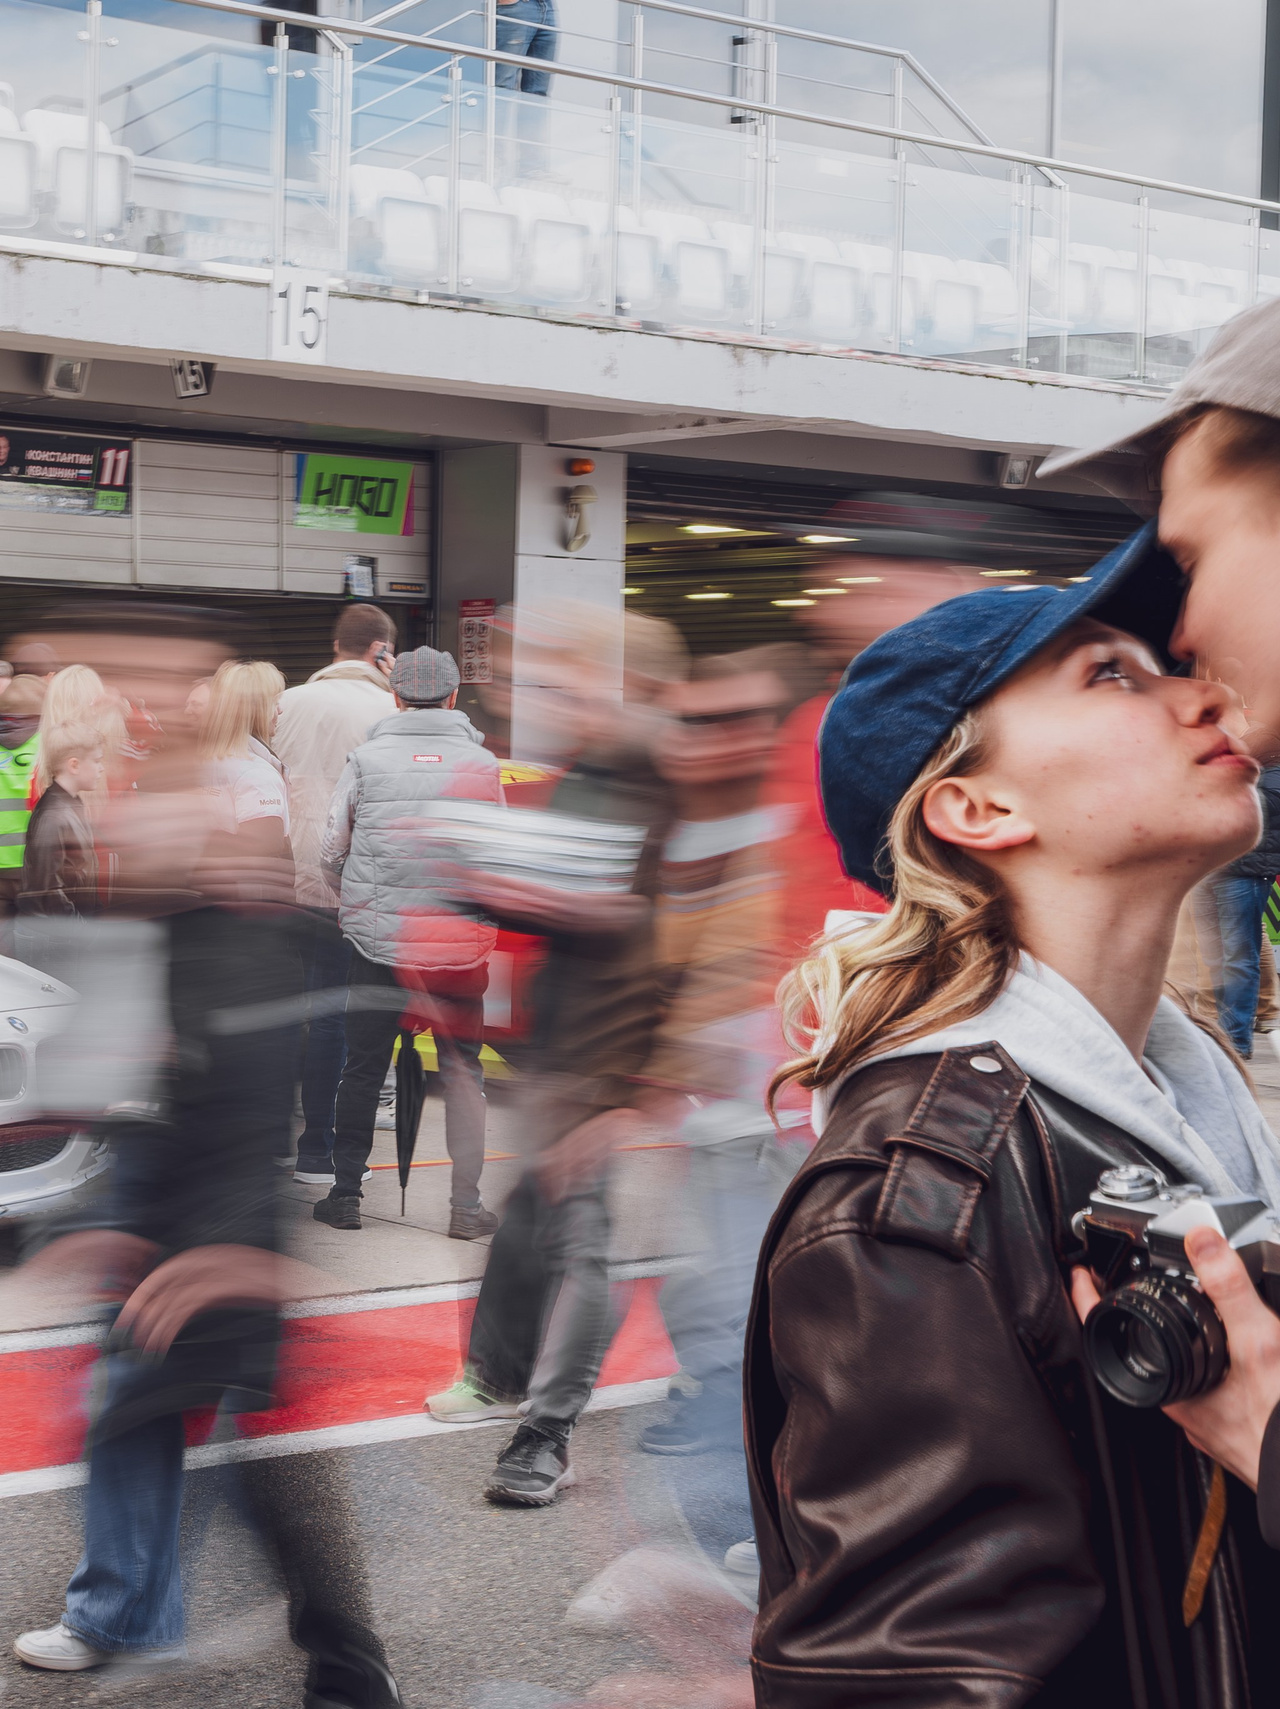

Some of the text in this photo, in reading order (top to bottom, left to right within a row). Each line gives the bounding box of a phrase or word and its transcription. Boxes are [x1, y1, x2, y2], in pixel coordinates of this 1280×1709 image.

[277, 282, 320, 350] 15
[25, 449, 94, 465] КОНСТАНТИН
[99, 447, 130, 486] 11
